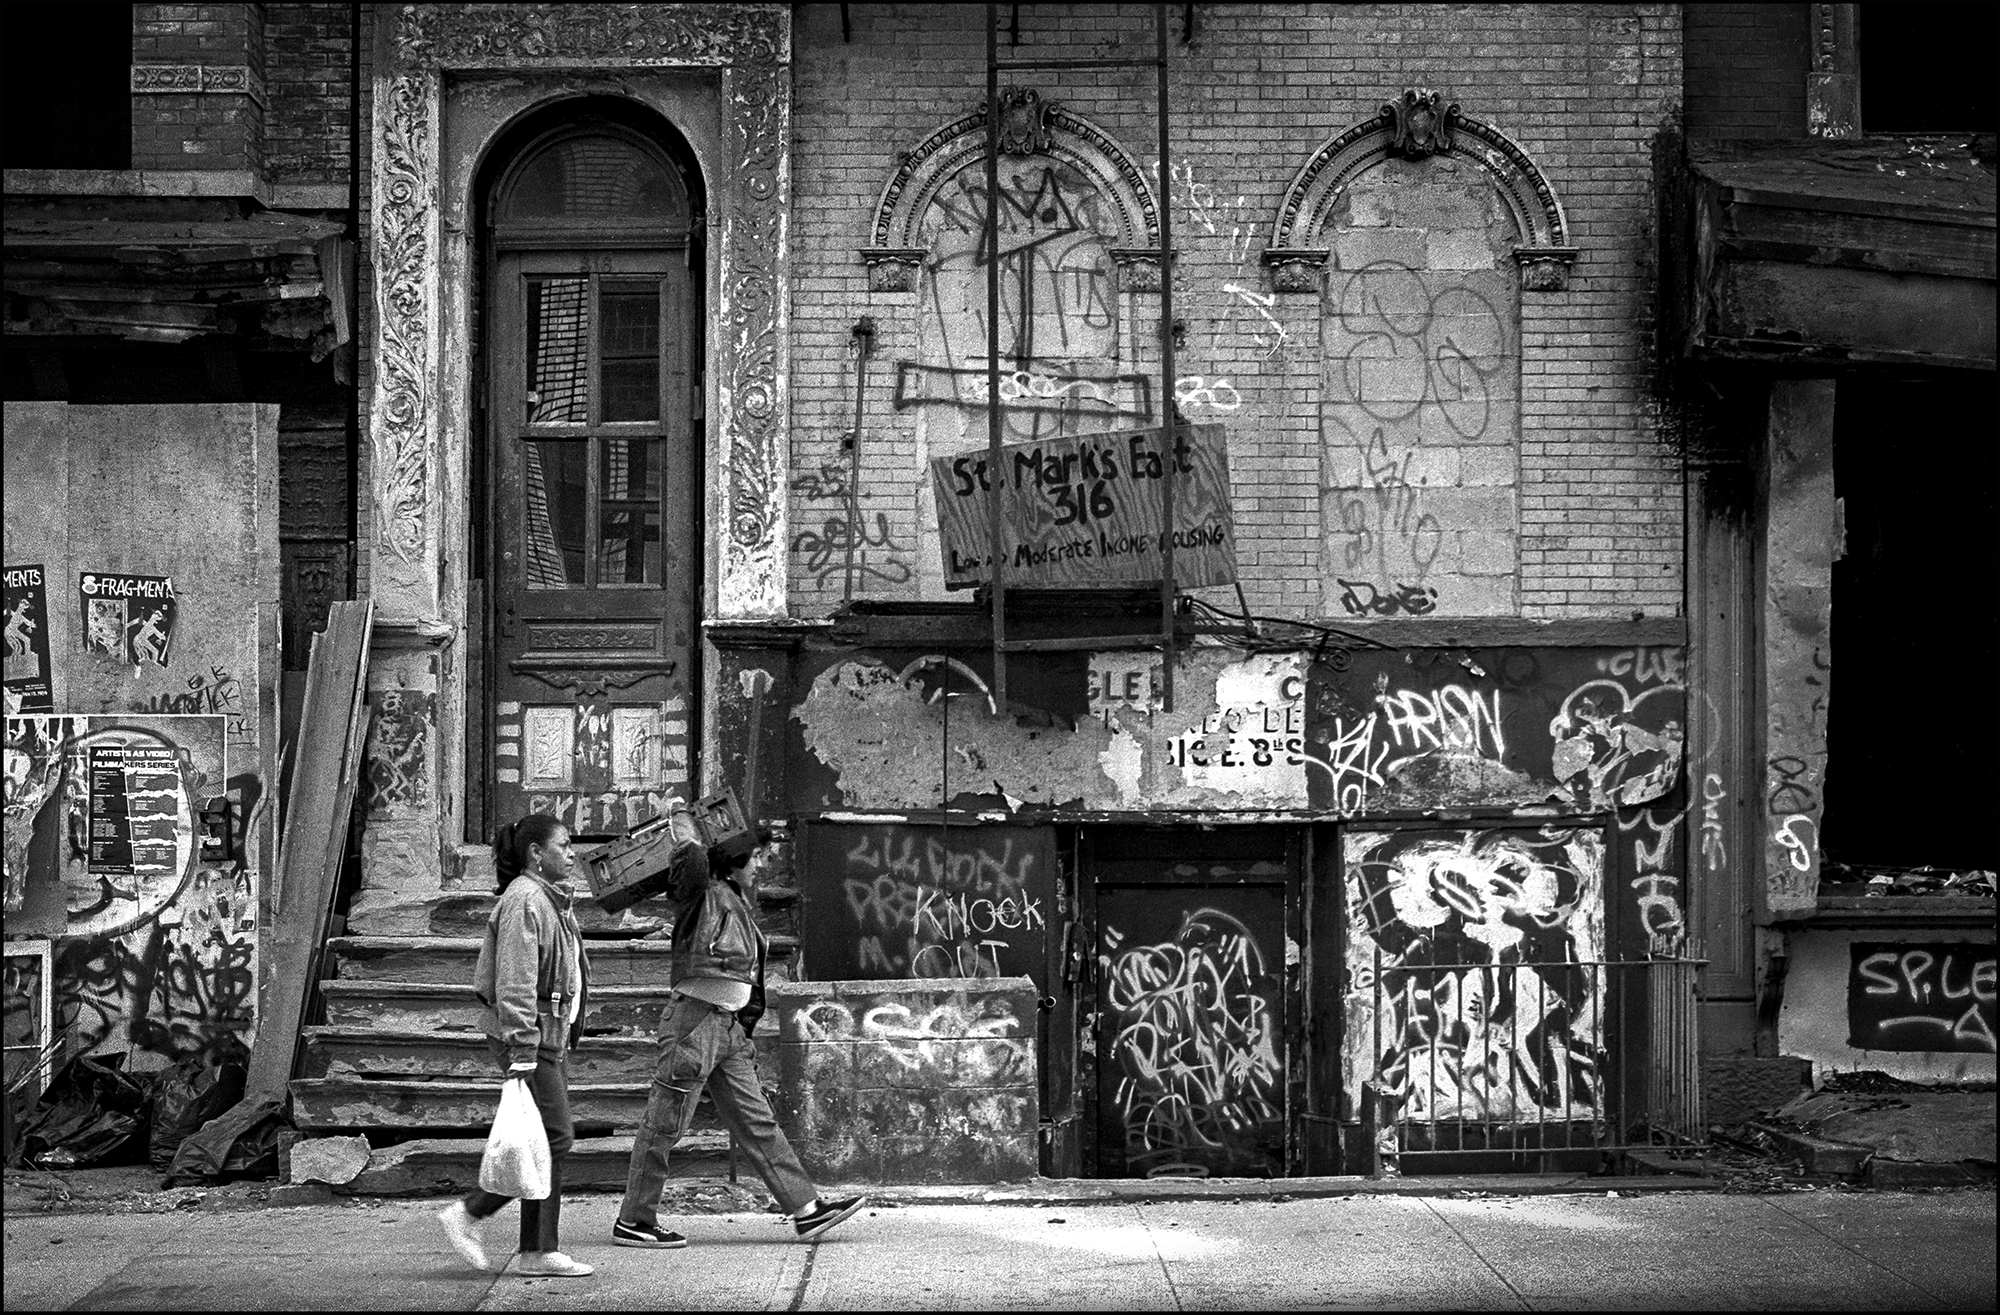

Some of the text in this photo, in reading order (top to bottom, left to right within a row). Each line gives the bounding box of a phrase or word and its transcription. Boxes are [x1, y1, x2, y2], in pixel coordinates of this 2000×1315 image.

[1014, 443, 1118, 490] Mark's
[1129, 436, 1194, 480] Eat
[1047, 480, 1115, 526] 316
